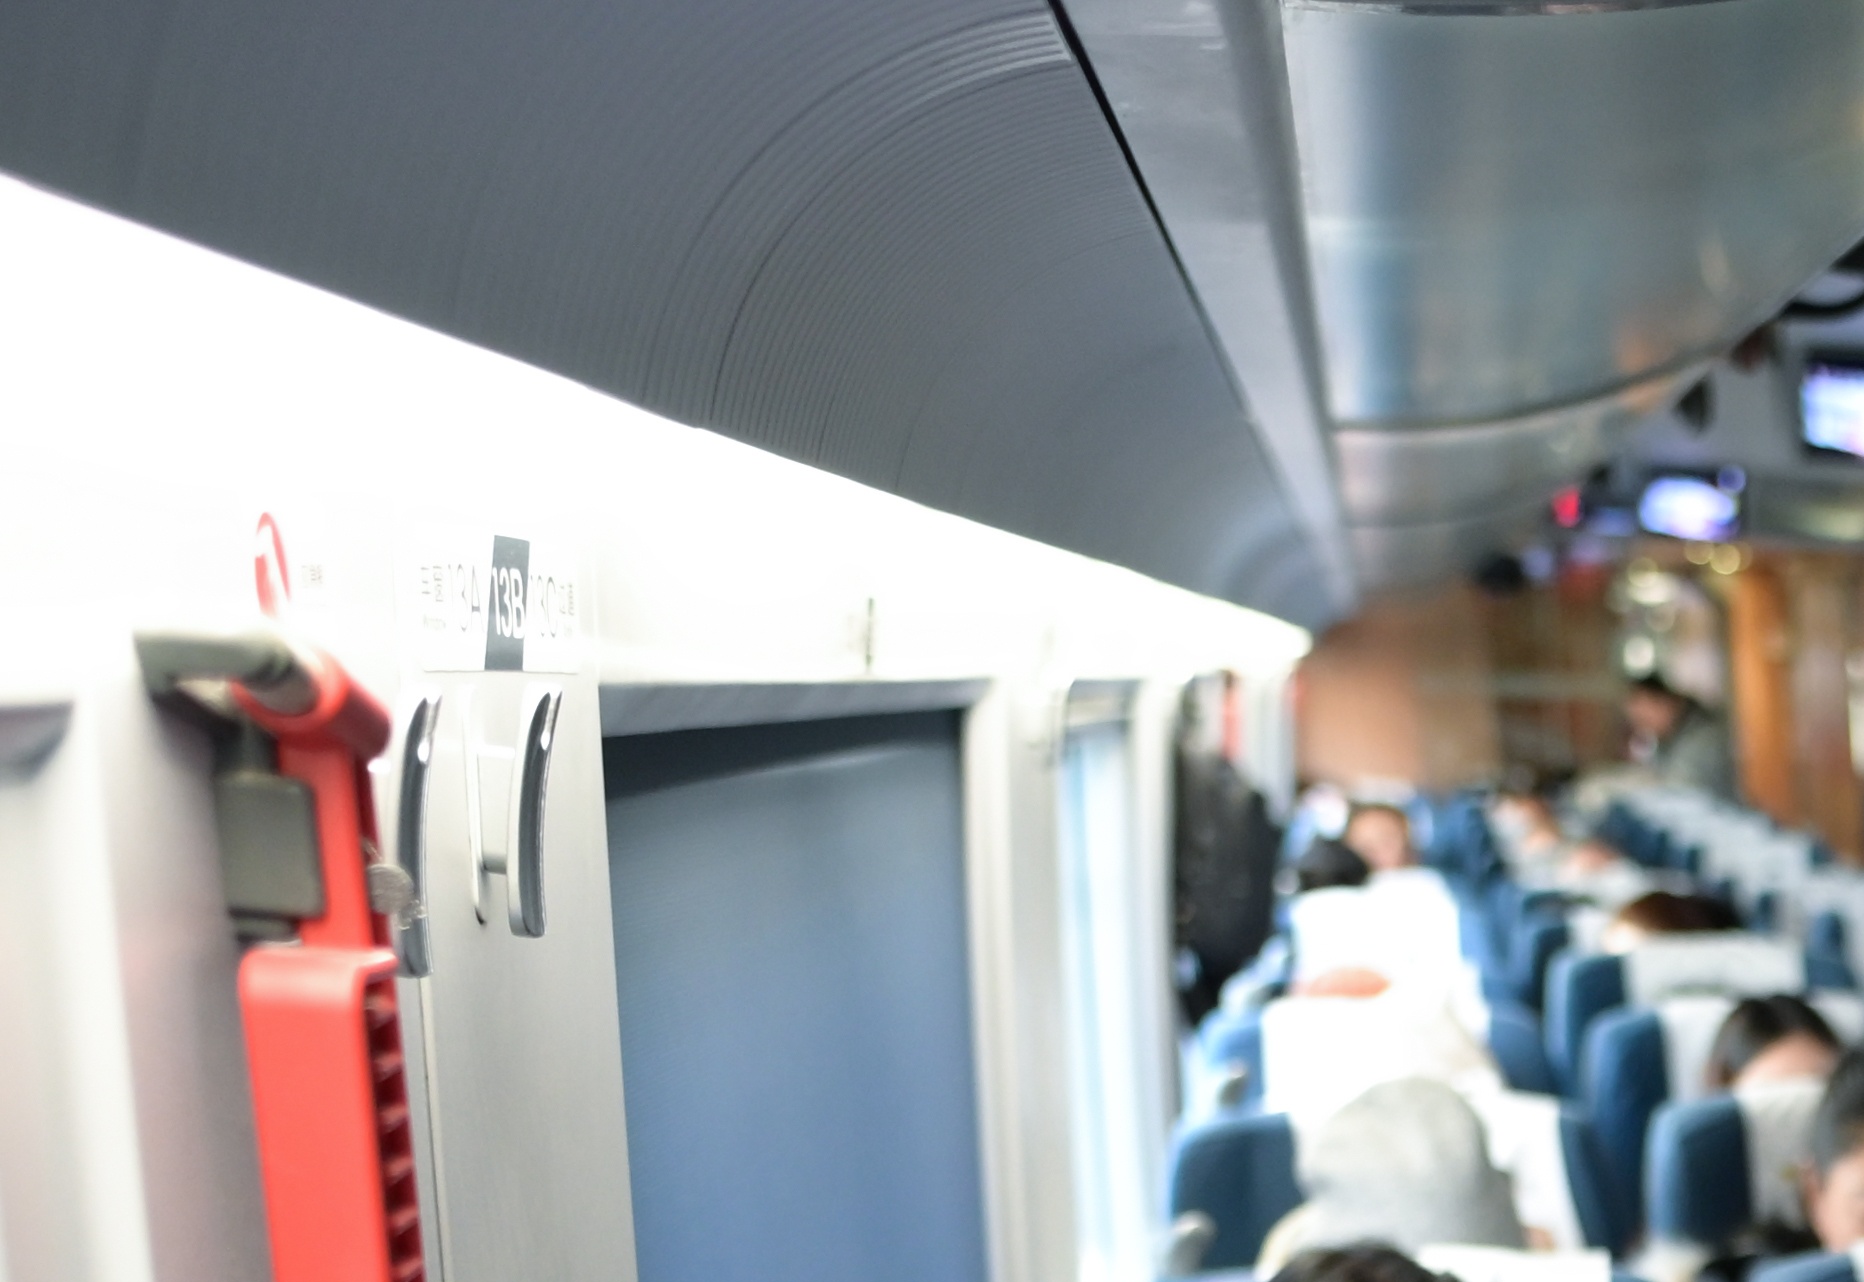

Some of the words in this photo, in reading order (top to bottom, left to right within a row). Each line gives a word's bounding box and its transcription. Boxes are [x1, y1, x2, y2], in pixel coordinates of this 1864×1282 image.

[447, 563, 486, 633] 13A
[492, 567, 525, 639] 13B
[530, 574, 558, 639] 13C
